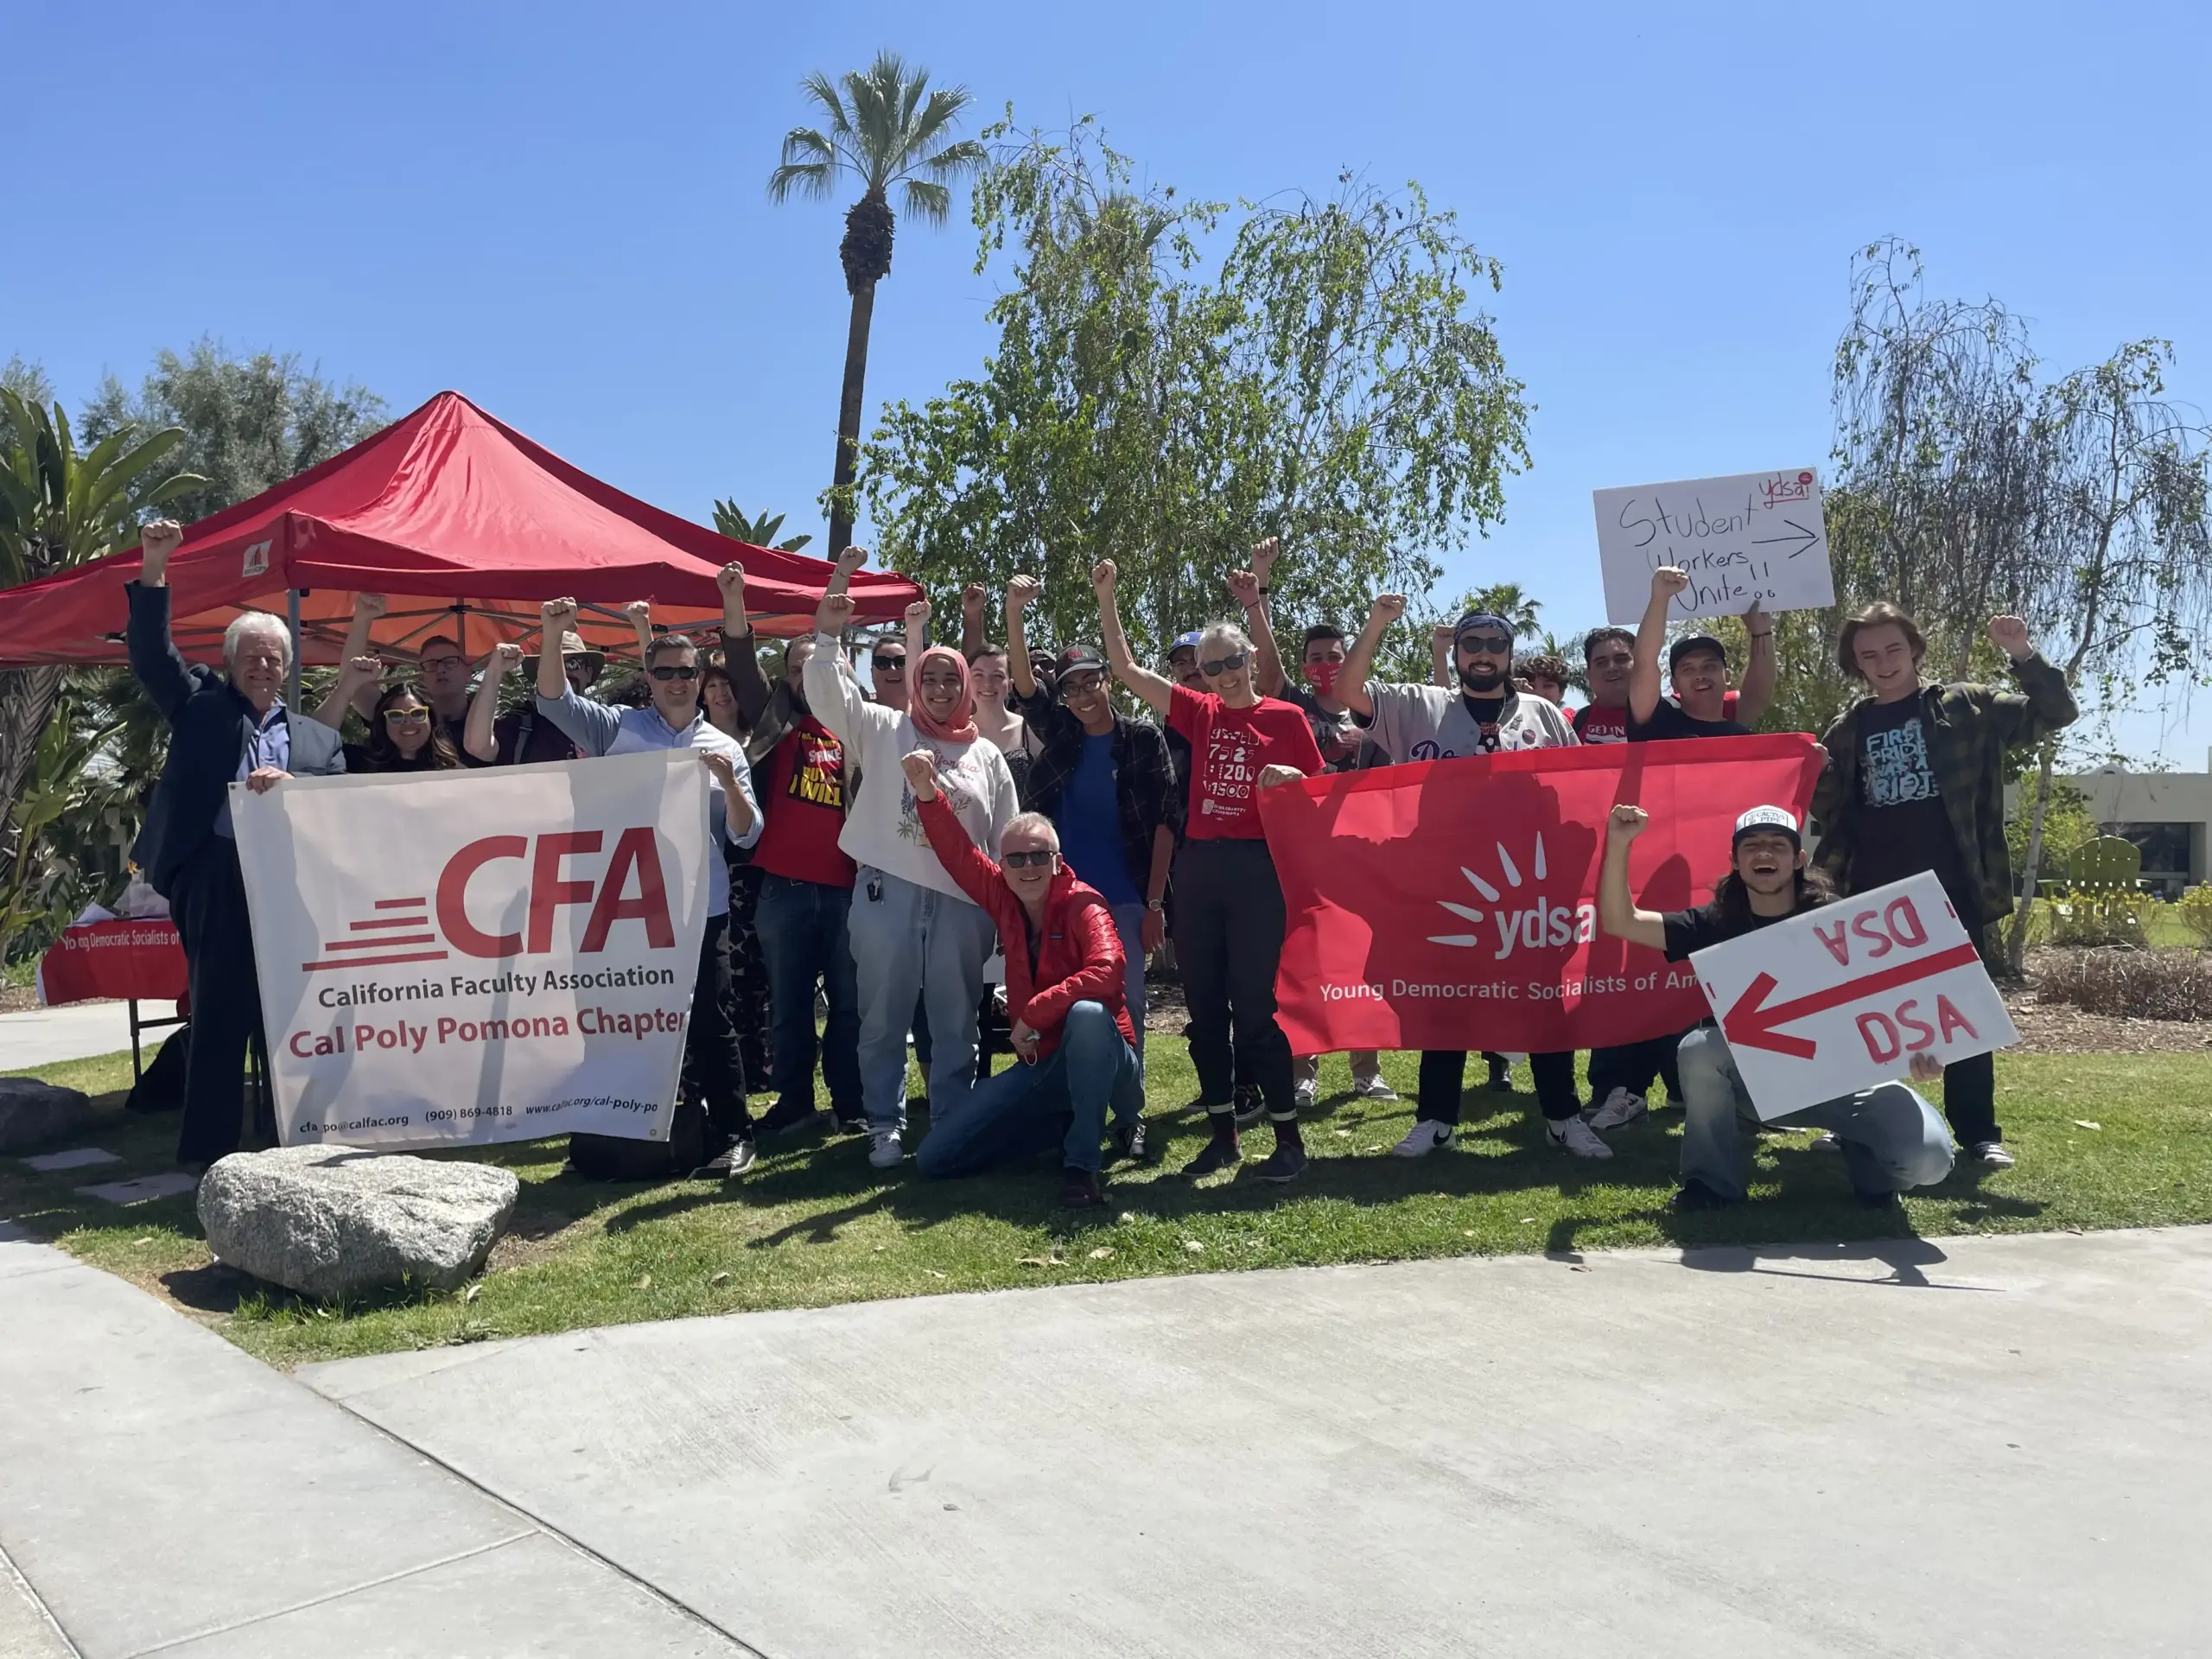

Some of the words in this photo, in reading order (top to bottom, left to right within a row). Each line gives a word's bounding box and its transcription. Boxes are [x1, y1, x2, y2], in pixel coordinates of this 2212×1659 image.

[1619, 493, 1759, 547] Student
[1587, 724, 1608, 734] GET
[1610, 725, 1625, 735] IN
[1866, 723, 1923, 752] FIRST
[1869, 739, 1927, 766] PRIDE
[800, 776, 842, 807] WILL
[1757, 811, 1785, 820] CACTUS
[436, 826, 676, 958] CFA
[90, 930, 130, 948] Democratic
[132, 929, 168, 946] Socialists
[1494, 895, 1597, 960] ydsa
[1812, 894, 1929, 967] DSA
[319, 978, 444, 1008] California
[451, 972, 537, 996] Faculty
[543, 964, 674, 991] Association
[1319, 982, 1384, 1002] Young
[1392, 979, 1519, 1000] Democratic
[1527, 974, 1627, 1001] Socialists
[1634, 971, 1657, 991] of
[289, 1027, 345, 1058] Cal
[355, 1020, 429, 1054] Poly
[437, 1011, 569, 1044] Pomona
[575, 1006, 684, 1039] Chapter
[1855, 994, 1980, 1065] DSA
[425, 1108, 457, 1123] (909)
[460, 1105, 512, 1119] 869-4818
